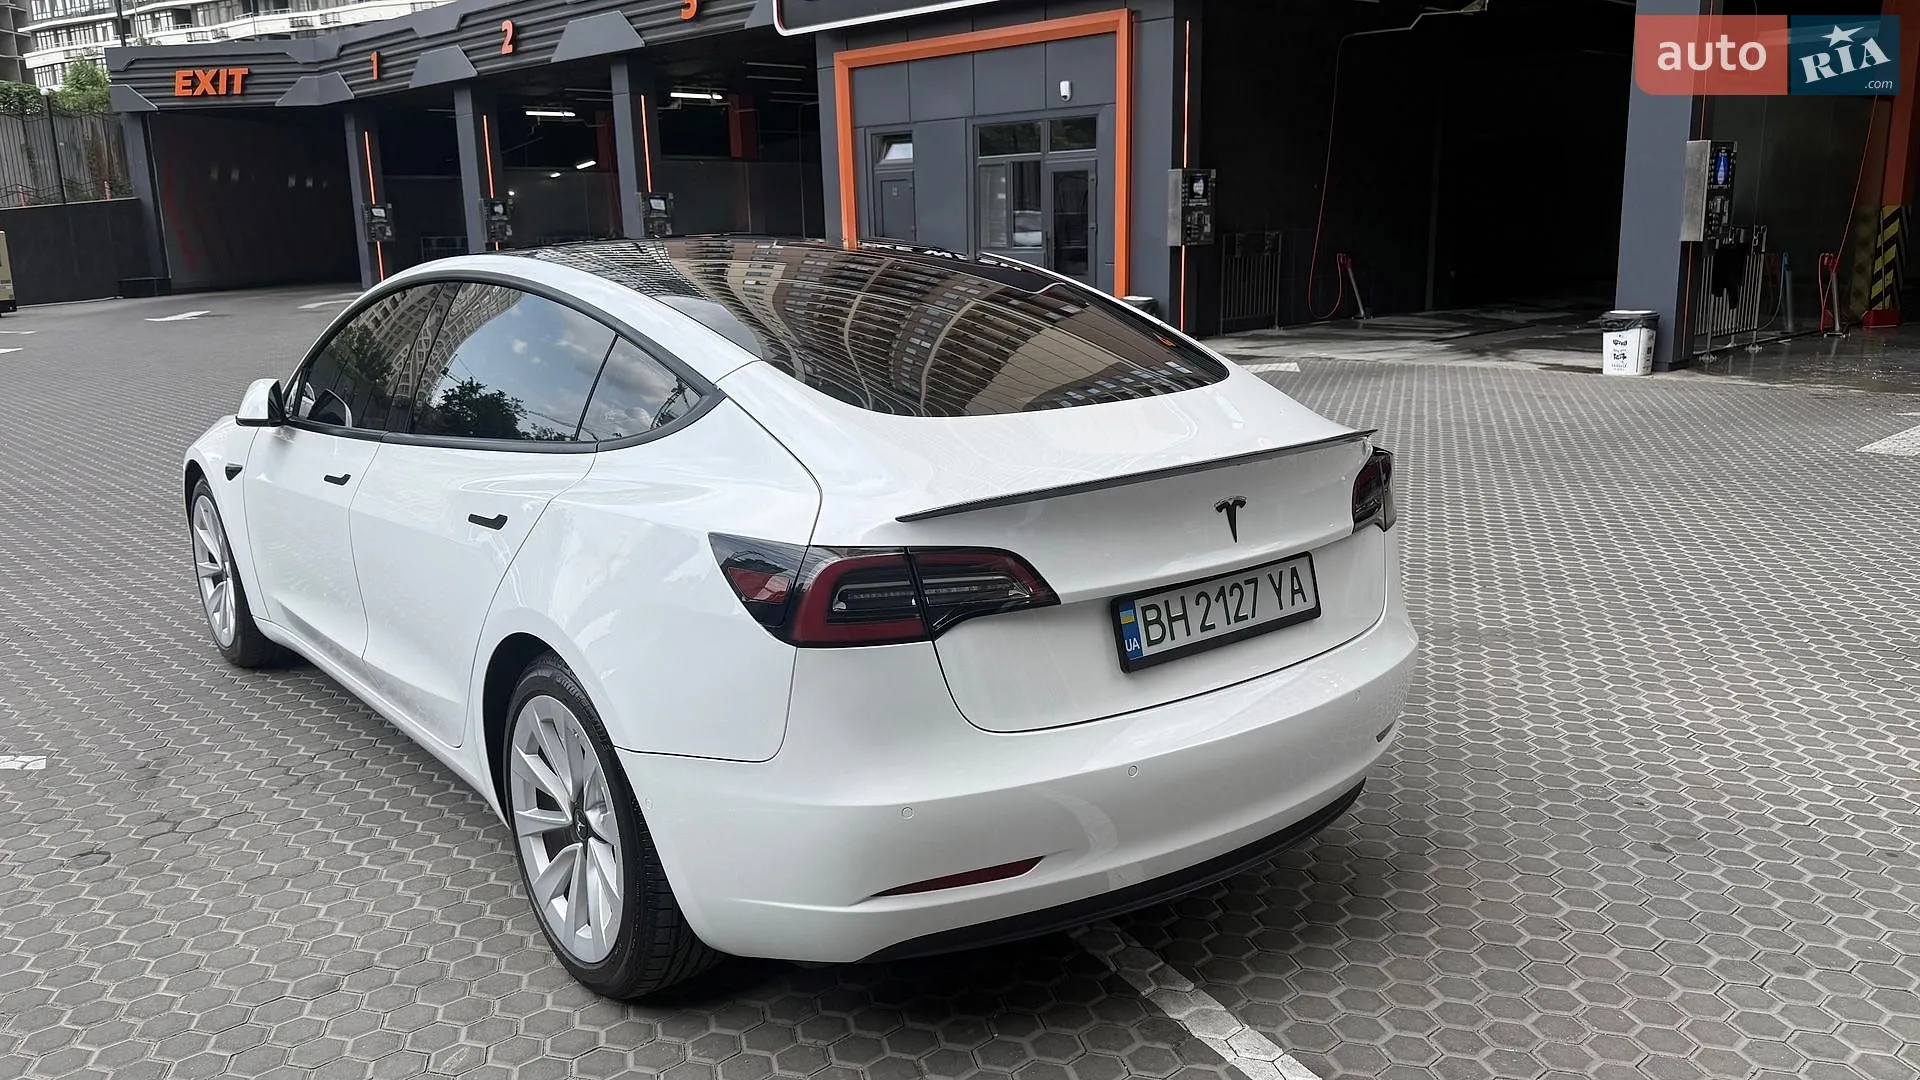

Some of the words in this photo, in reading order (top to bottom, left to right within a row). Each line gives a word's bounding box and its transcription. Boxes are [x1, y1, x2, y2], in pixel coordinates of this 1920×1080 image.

[501, 20, 514, 54] 2
[370, 51, 379, 80] 1
[175, 68, 248, 97] EXIT
[1141, 595, 1191, 647] BH
[1195, 577, 1259, 633] 2127
[1267, 566, 1308, 611] YA
[1125, 637, 1141, 652] UA
